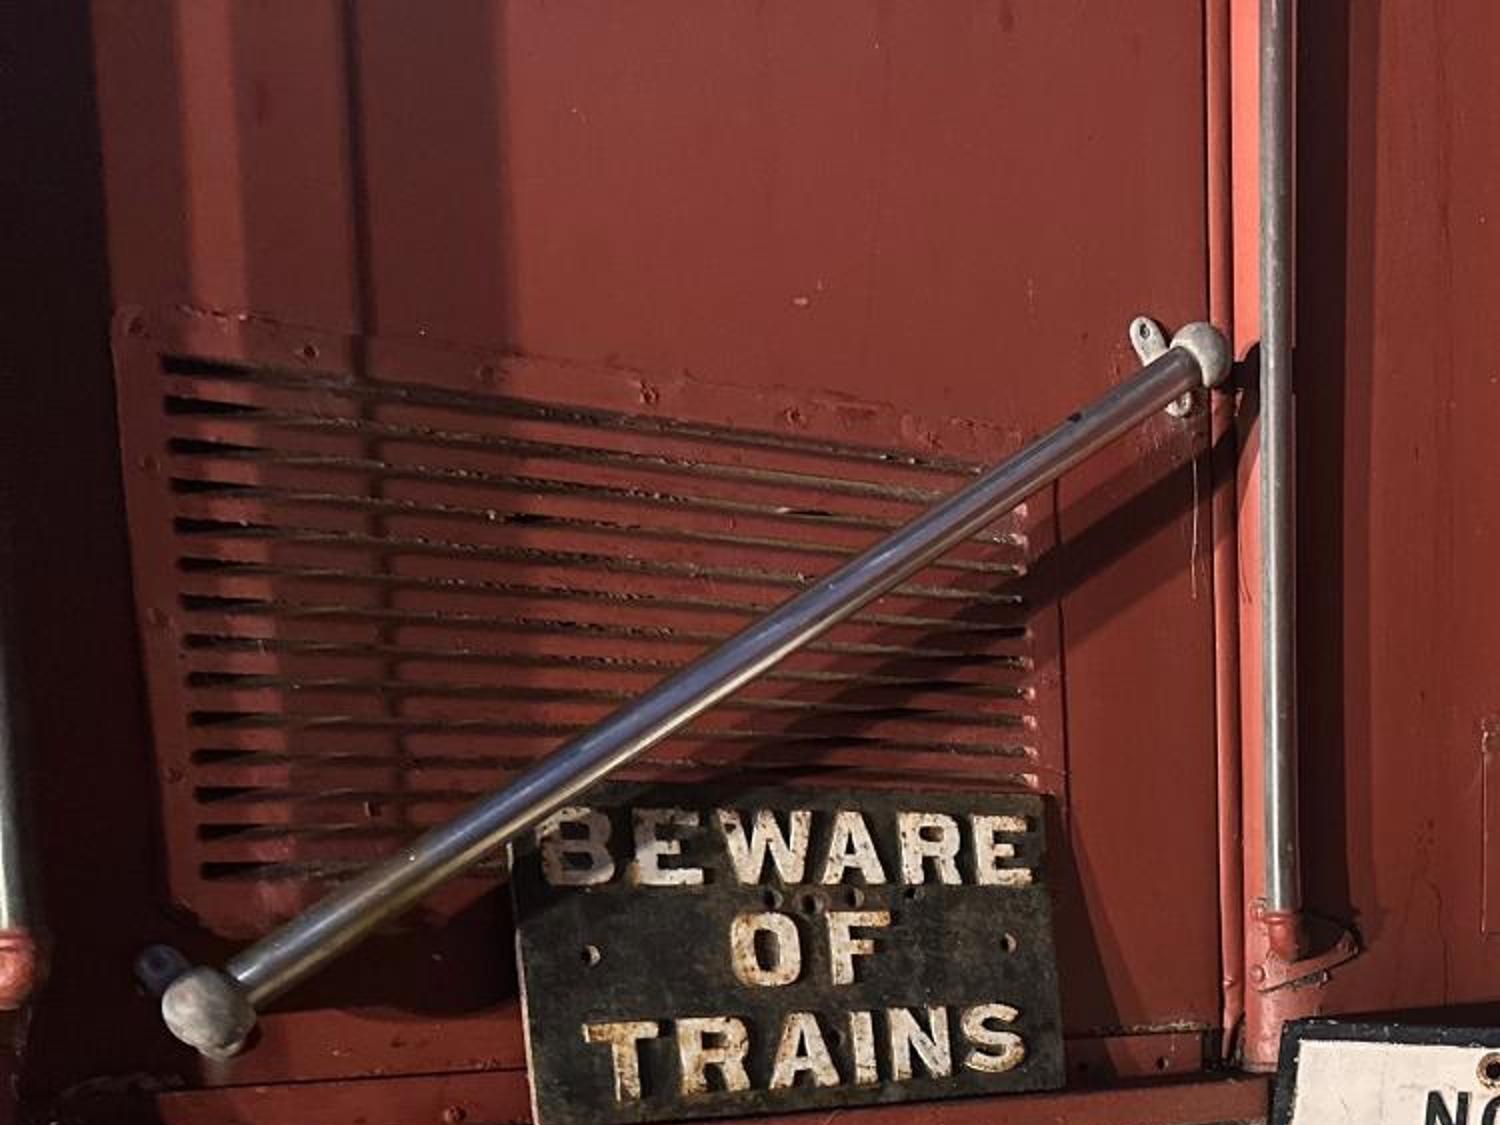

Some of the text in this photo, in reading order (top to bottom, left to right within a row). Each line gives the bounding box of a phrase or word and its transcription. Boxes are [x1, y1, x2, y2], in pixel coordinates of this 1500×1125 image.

[536, 806, 1034, 888] BEWARE
[730, 910, 892, 988] OF
[582, 1003, 1027, 1102] TRAINS
